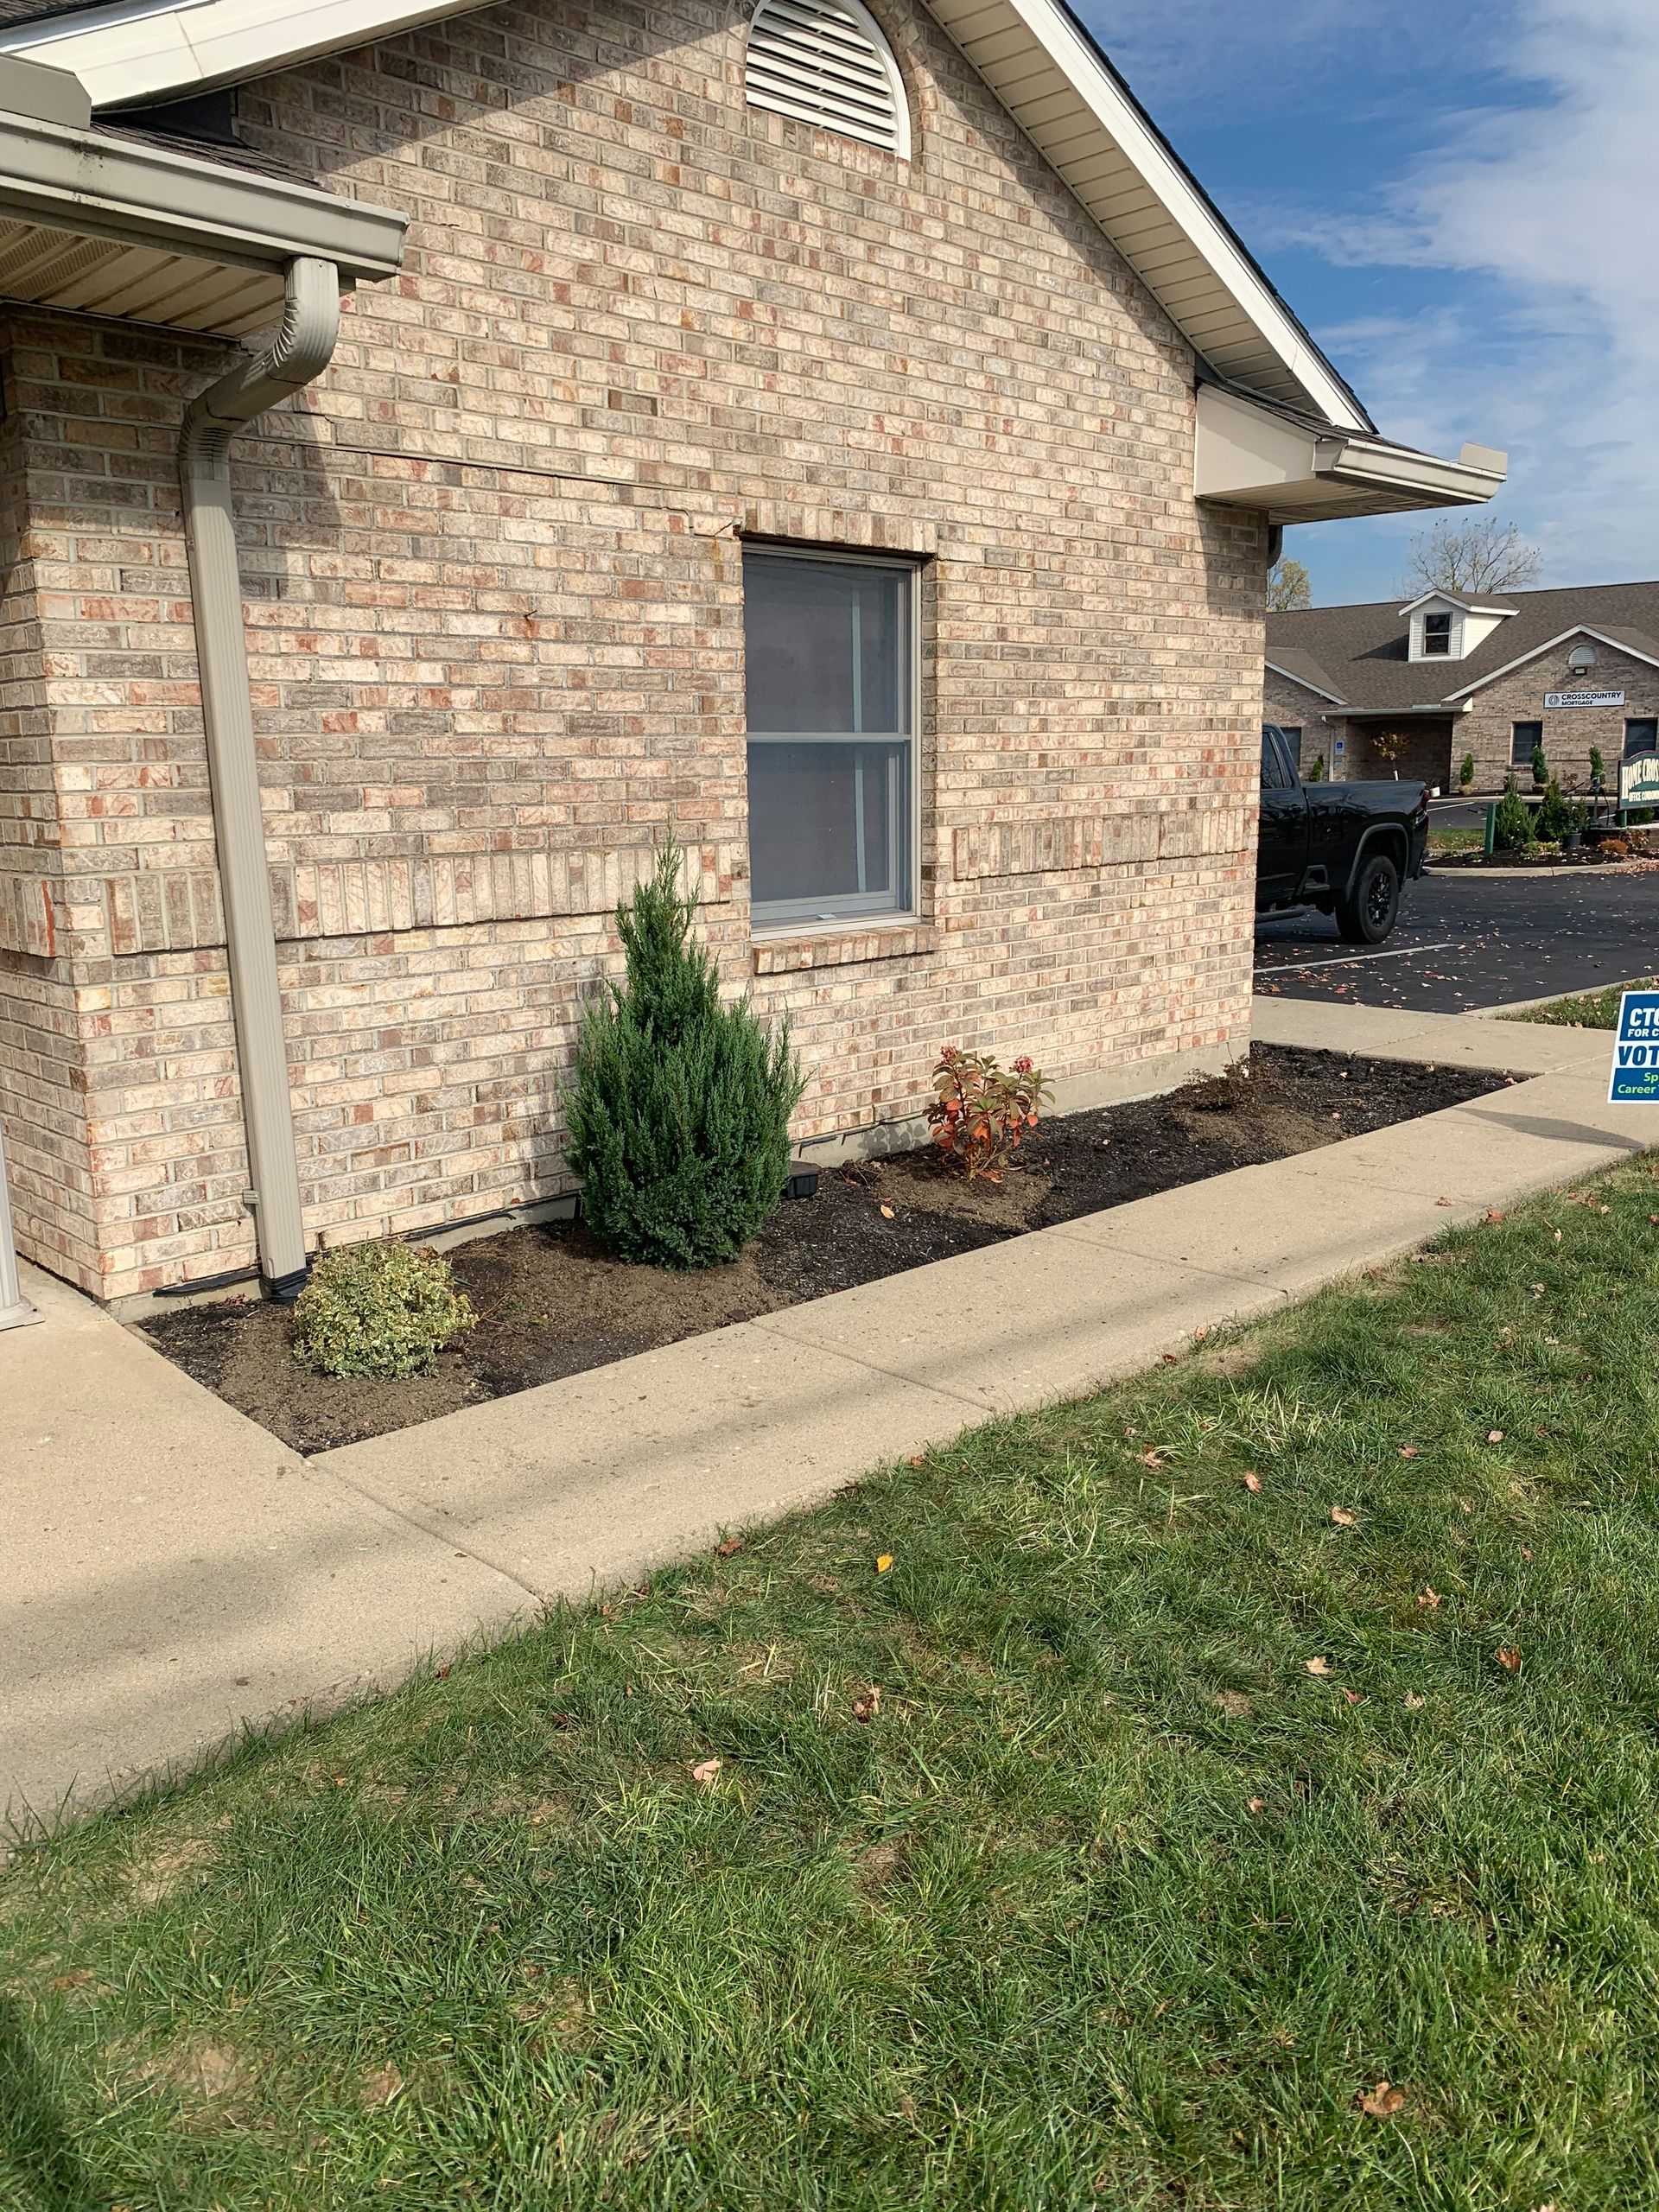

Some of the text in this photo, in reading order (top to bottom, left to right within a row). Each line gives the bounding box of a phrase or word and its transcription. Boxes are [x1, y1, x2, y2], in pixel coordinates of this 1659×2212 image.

[1622, 760, 1642, 799] HOME
[1627, 1028, 1659, 1037] FOR C
[1618, 1046, 1659, 1065] VOT
[1643, 1072, 1659, 1084] Sp
[1618, 1084, 1656, 1093] Career
